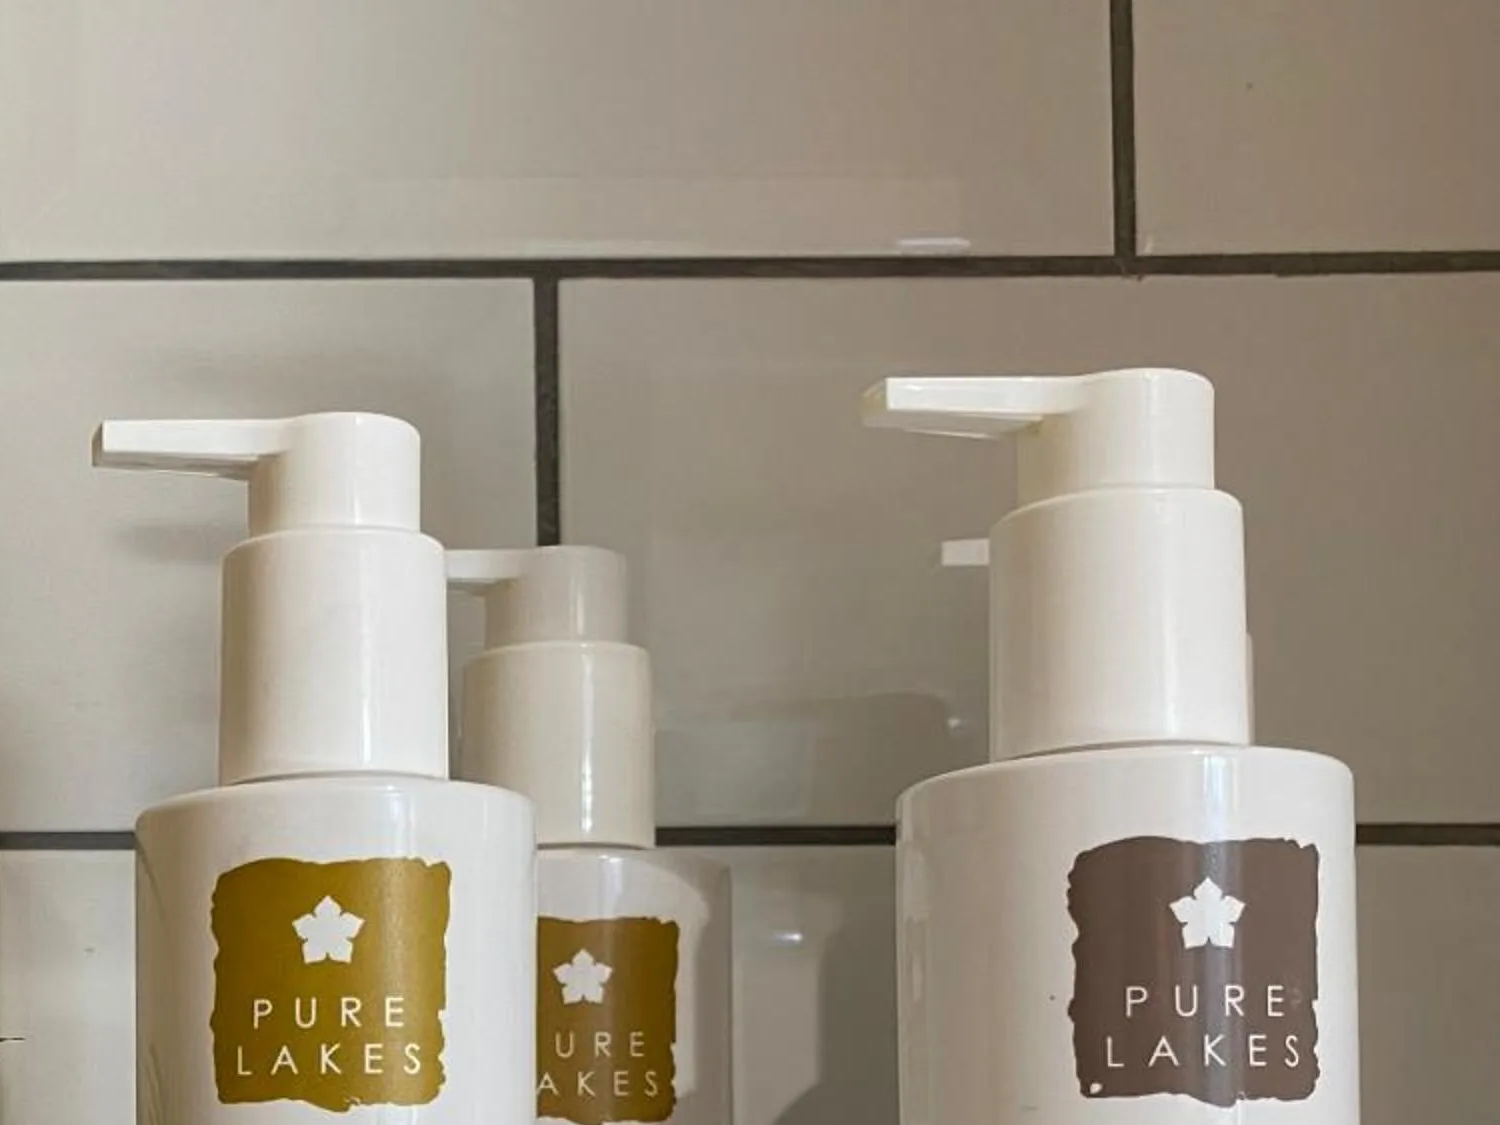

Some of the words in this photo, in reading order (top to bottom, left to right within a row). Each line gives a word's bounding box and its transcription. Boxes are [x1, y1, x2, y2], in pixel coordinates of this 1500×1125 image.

[253, 997, 404, 1028] PURE
[1126, 985, 1285, 1017] PURE
[237, 1043, 421, 1075] LAKES
[555, 1031, 645, 1058] URE
[1107, 1034, 1300, 1068] LAKES
[537, 1071, 658, 1097] AKES
